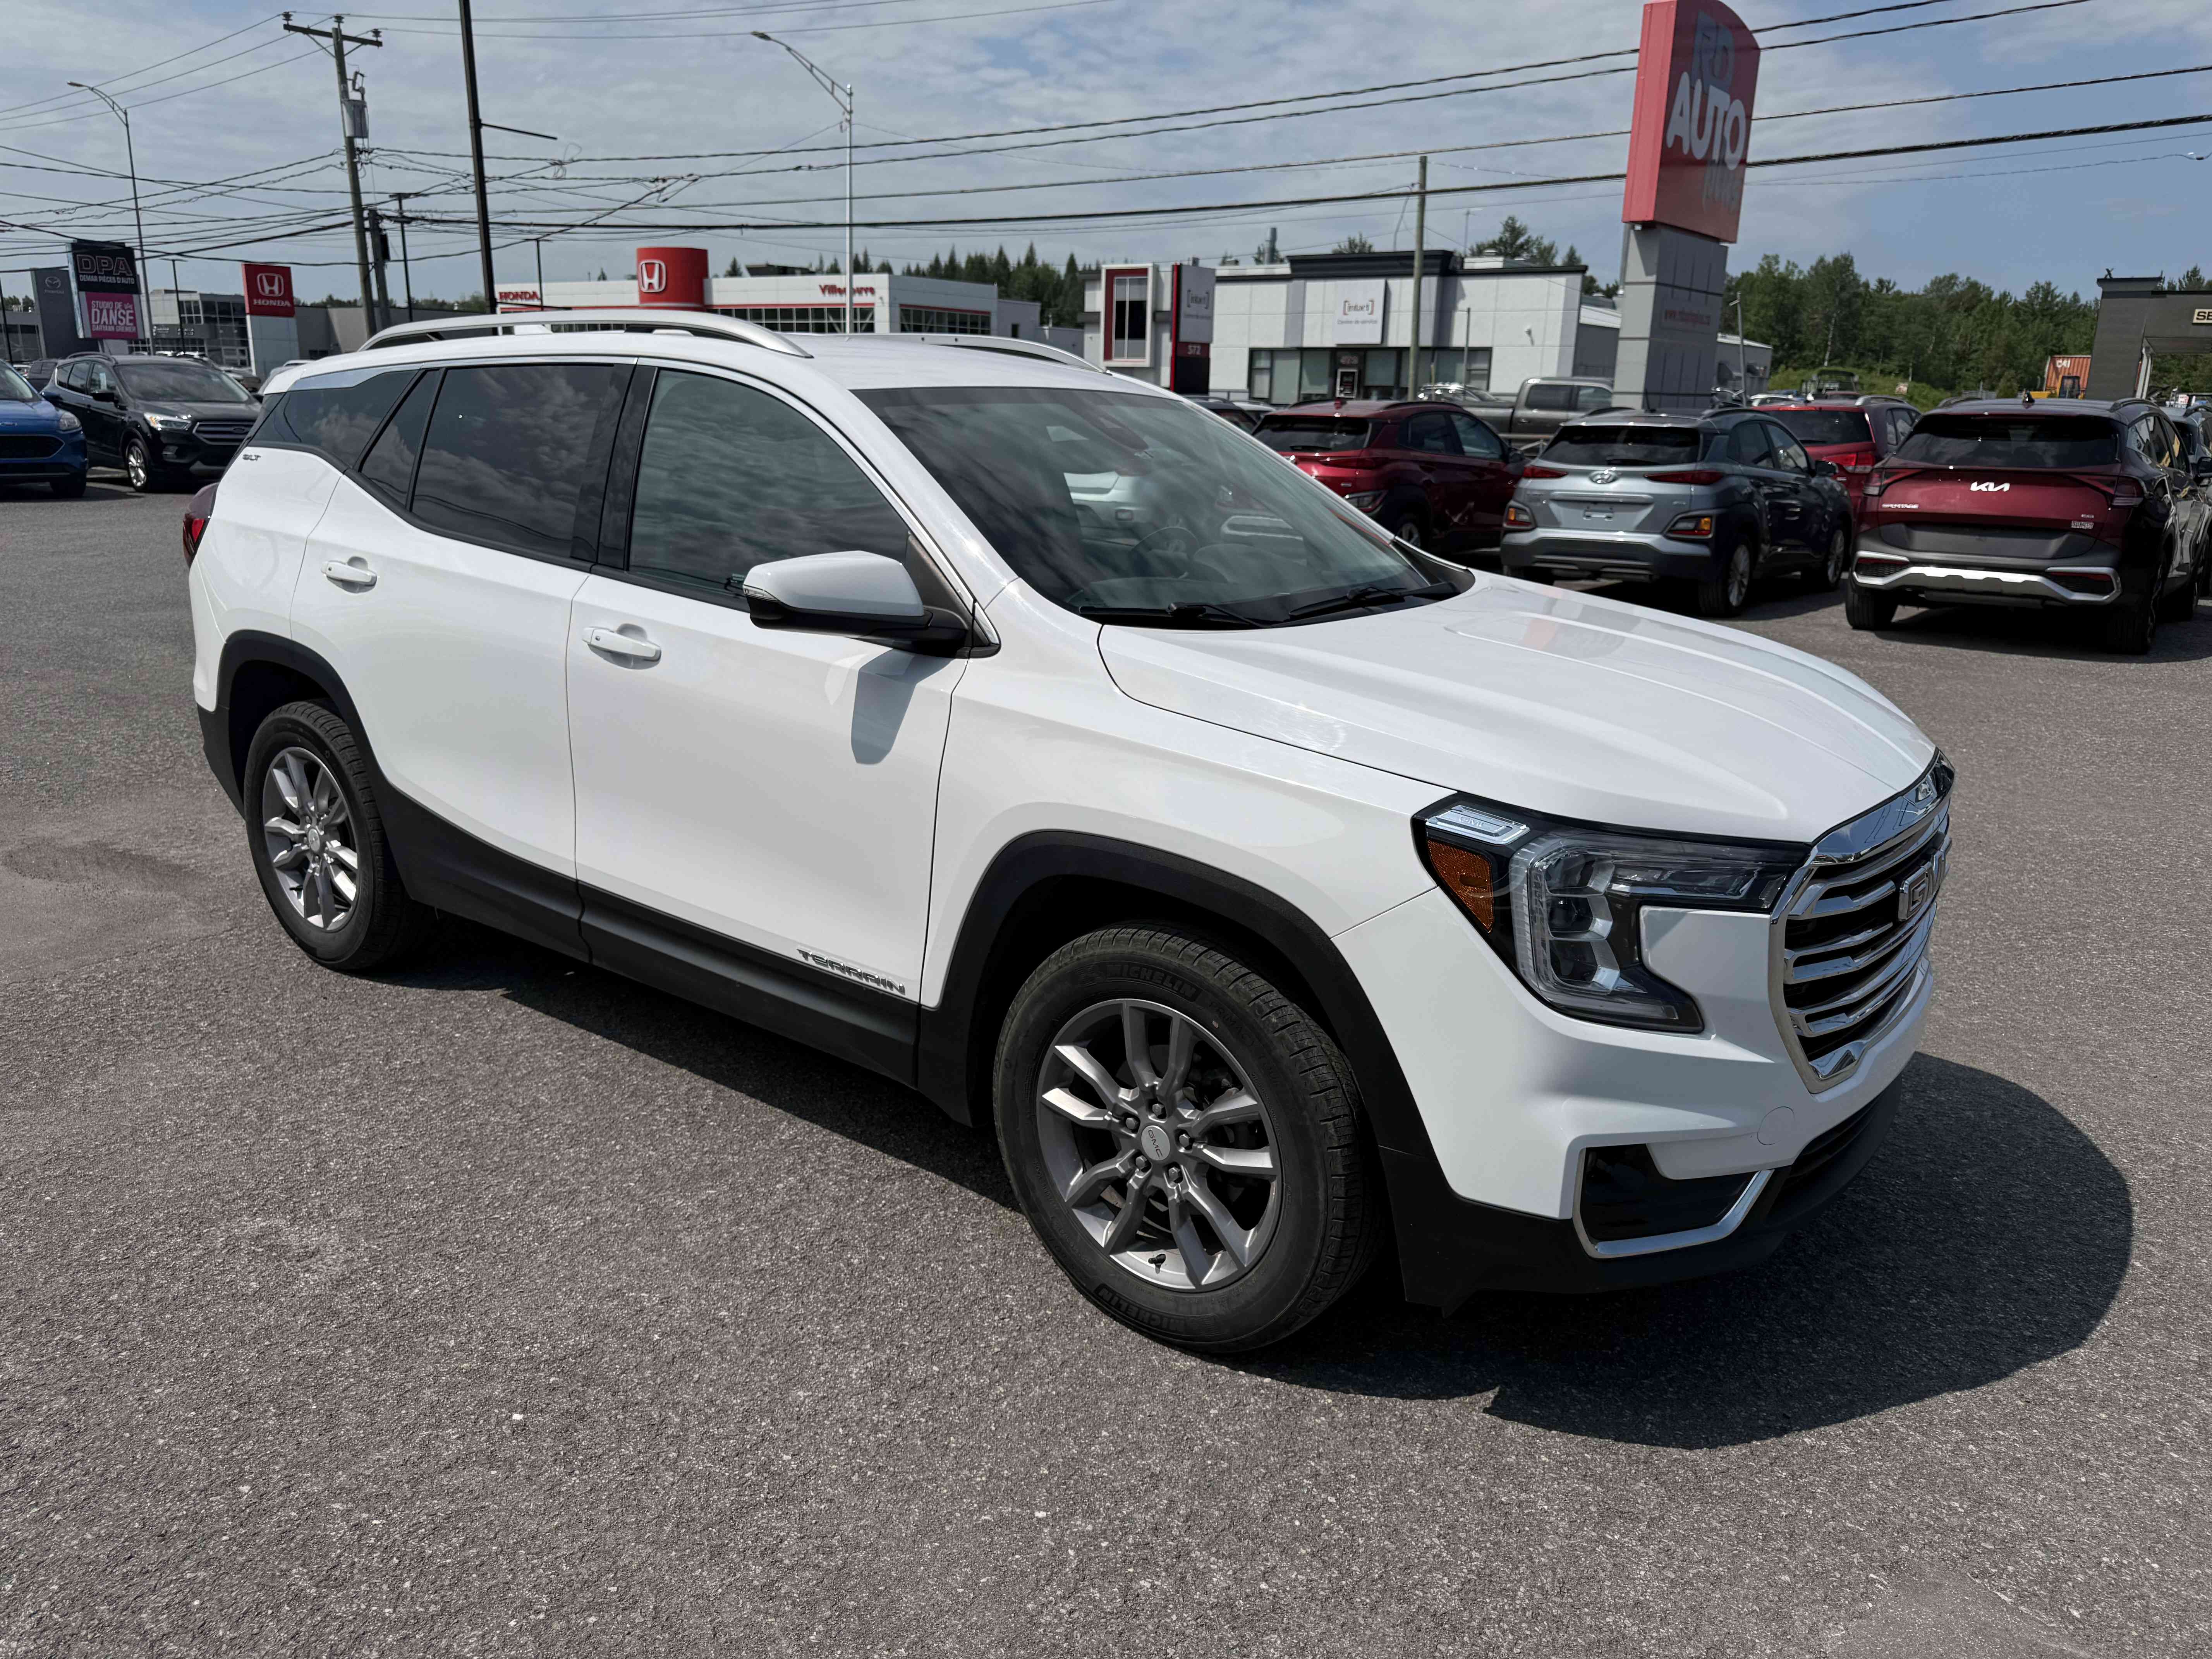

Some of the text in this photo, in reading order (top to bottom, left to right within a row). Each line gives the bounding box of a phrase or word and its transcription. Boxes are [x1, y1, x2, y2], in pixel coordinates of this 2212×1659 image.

[1667, 72, 1747, 170] AUTO
[77, 254, 133, 276] DPA
[91, 301, 113, 309] STUDIO
[499, 291, 539, 300] HONDA
[91, 309, 134, 326] DANSE
[1970, 482, 2010, 492] KIA
[797, 948, 905, 996] TERRAIN
[1105, 963, 1197, 997] MICHELIN
[1148, 1130, 1163, 1158] GMC
[1097, 1286, 1186, 1333] MICHELIN
